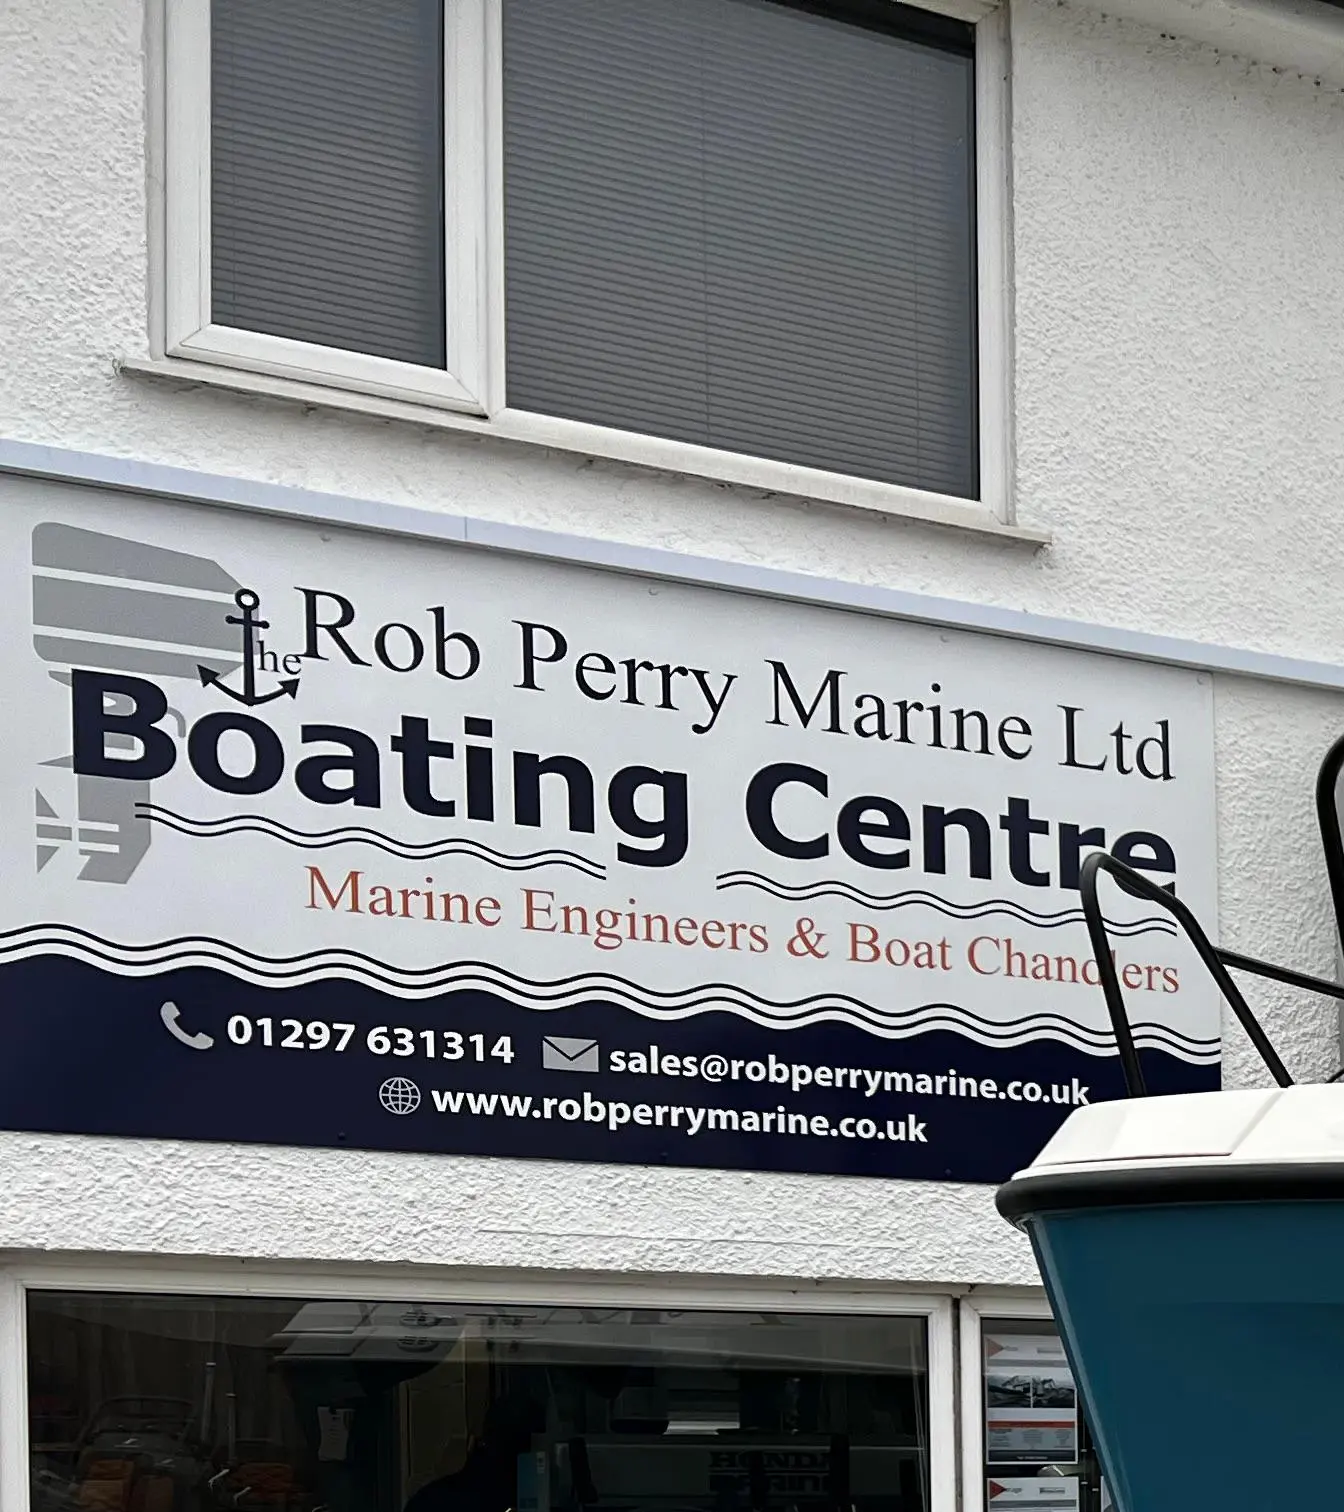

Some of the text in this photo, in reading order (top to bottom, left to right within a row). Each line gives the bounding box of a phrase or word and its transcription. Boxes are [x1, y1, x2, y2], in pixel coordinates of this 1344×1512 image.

[294, 587, 1176, 781] Rob Perry Marine Ltd
[71, 669, 1177, 899] Boating Centre
[304, 866, 501, 927] Marine
[520, 889, 769, 953] Engineers
[787, 917, 828, 960] &
[847, 922, 952, 973] Boat
[227, 1014, 1090, 1107] 01297 631314 sales@robperrymarine.co.uk
[431, 1080, 928, 1144] www.robperrymarine.co.uk
